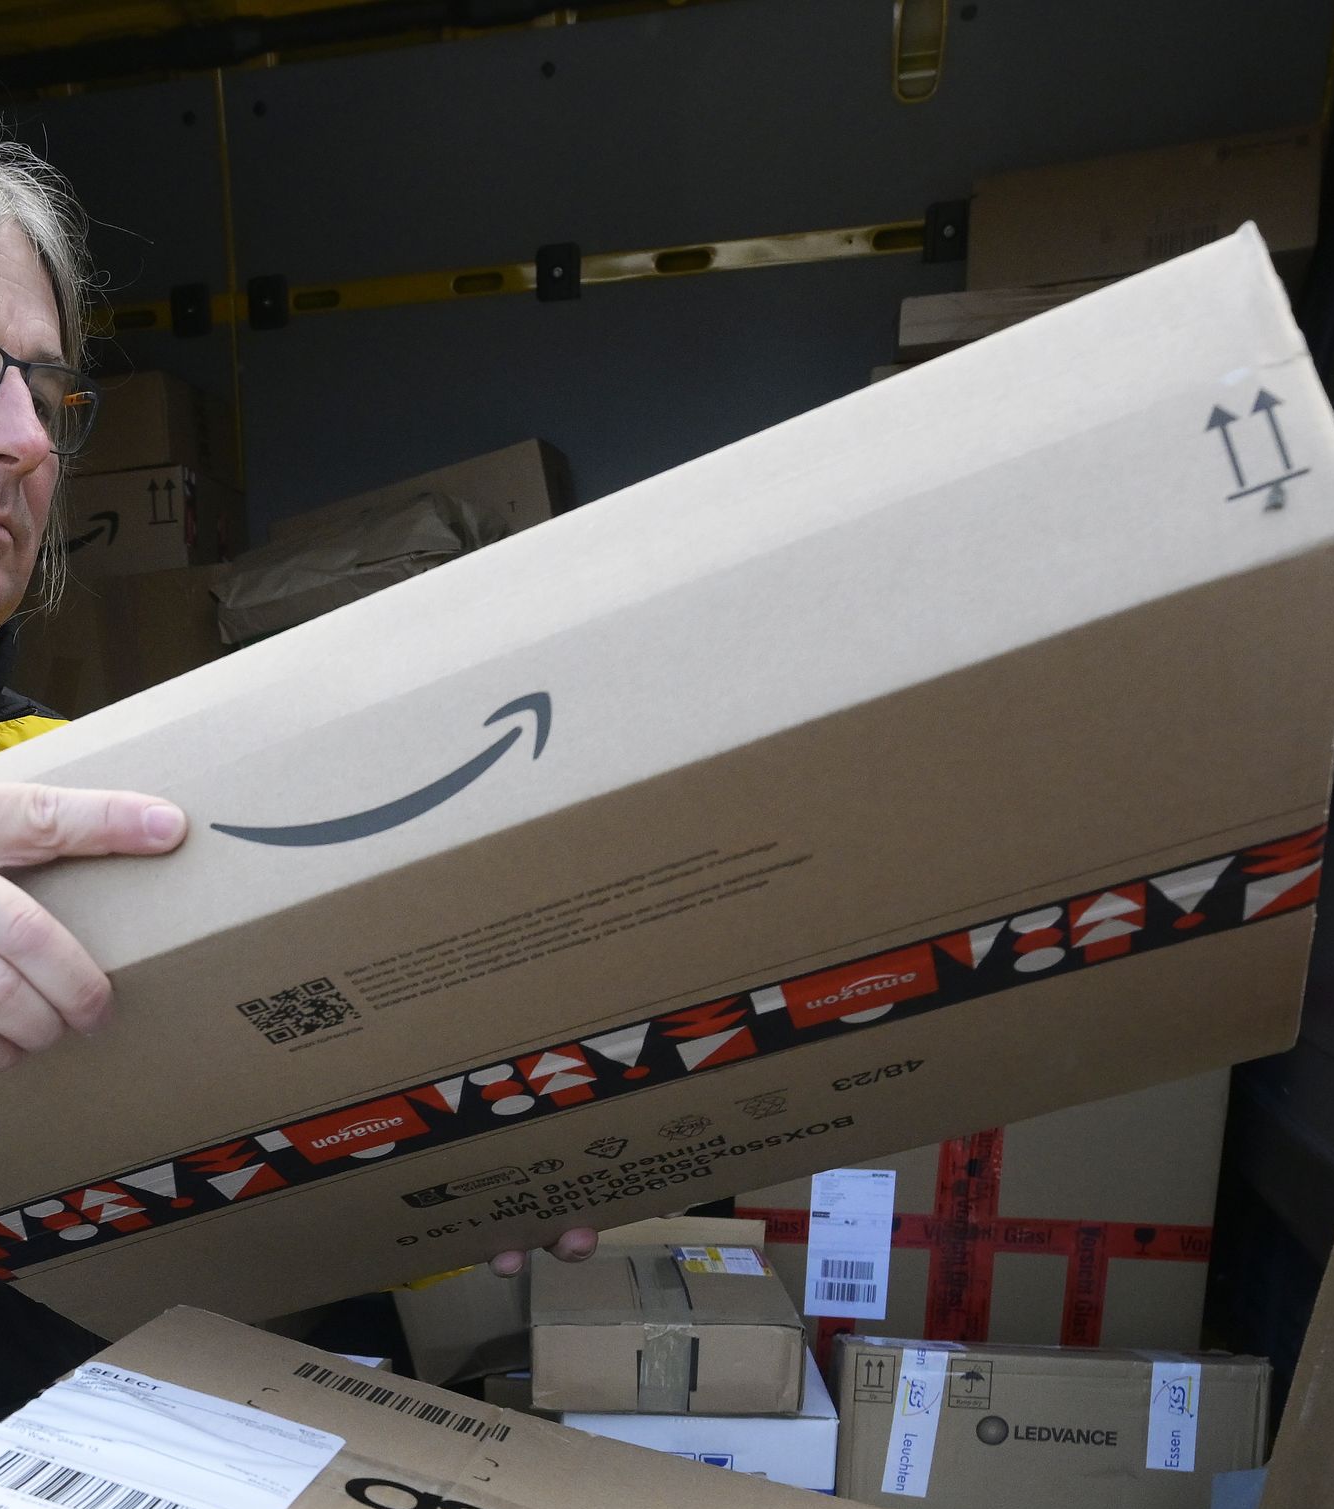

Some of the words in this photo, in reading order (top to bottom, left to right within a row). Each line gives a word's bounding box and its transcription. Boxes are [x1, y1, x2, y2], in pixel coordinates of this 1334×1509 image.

[805, 969, 917, 1011] amazon
[832, 1059, 925, 1093] 48/23
[310, 1116, 405, 1151] amazon
[547, 1115, 855, 1205] BOX550x350x50-100
[619, 1135, 726, 1174] printed
[536, 1166, 712, 1220] DCBOX1150
[543, 1169, 612, 1194] 2016
[489, 1201, 540, 1221] MM
[493, 1191, 538, 1208] VH
[396, 1235, 418, 1246] G
[427, 1218, 482, 1238] 1.30
[1004, 1227, 1052, 1246] Glas!
[88, 1367, 162, 1391] SELECT
[1014, 1425, 1118, 1446] LEDVANCE
[1165, 1430, 1181, 1468] Essen
[896, 1432, 918, 1491] Leuchten
